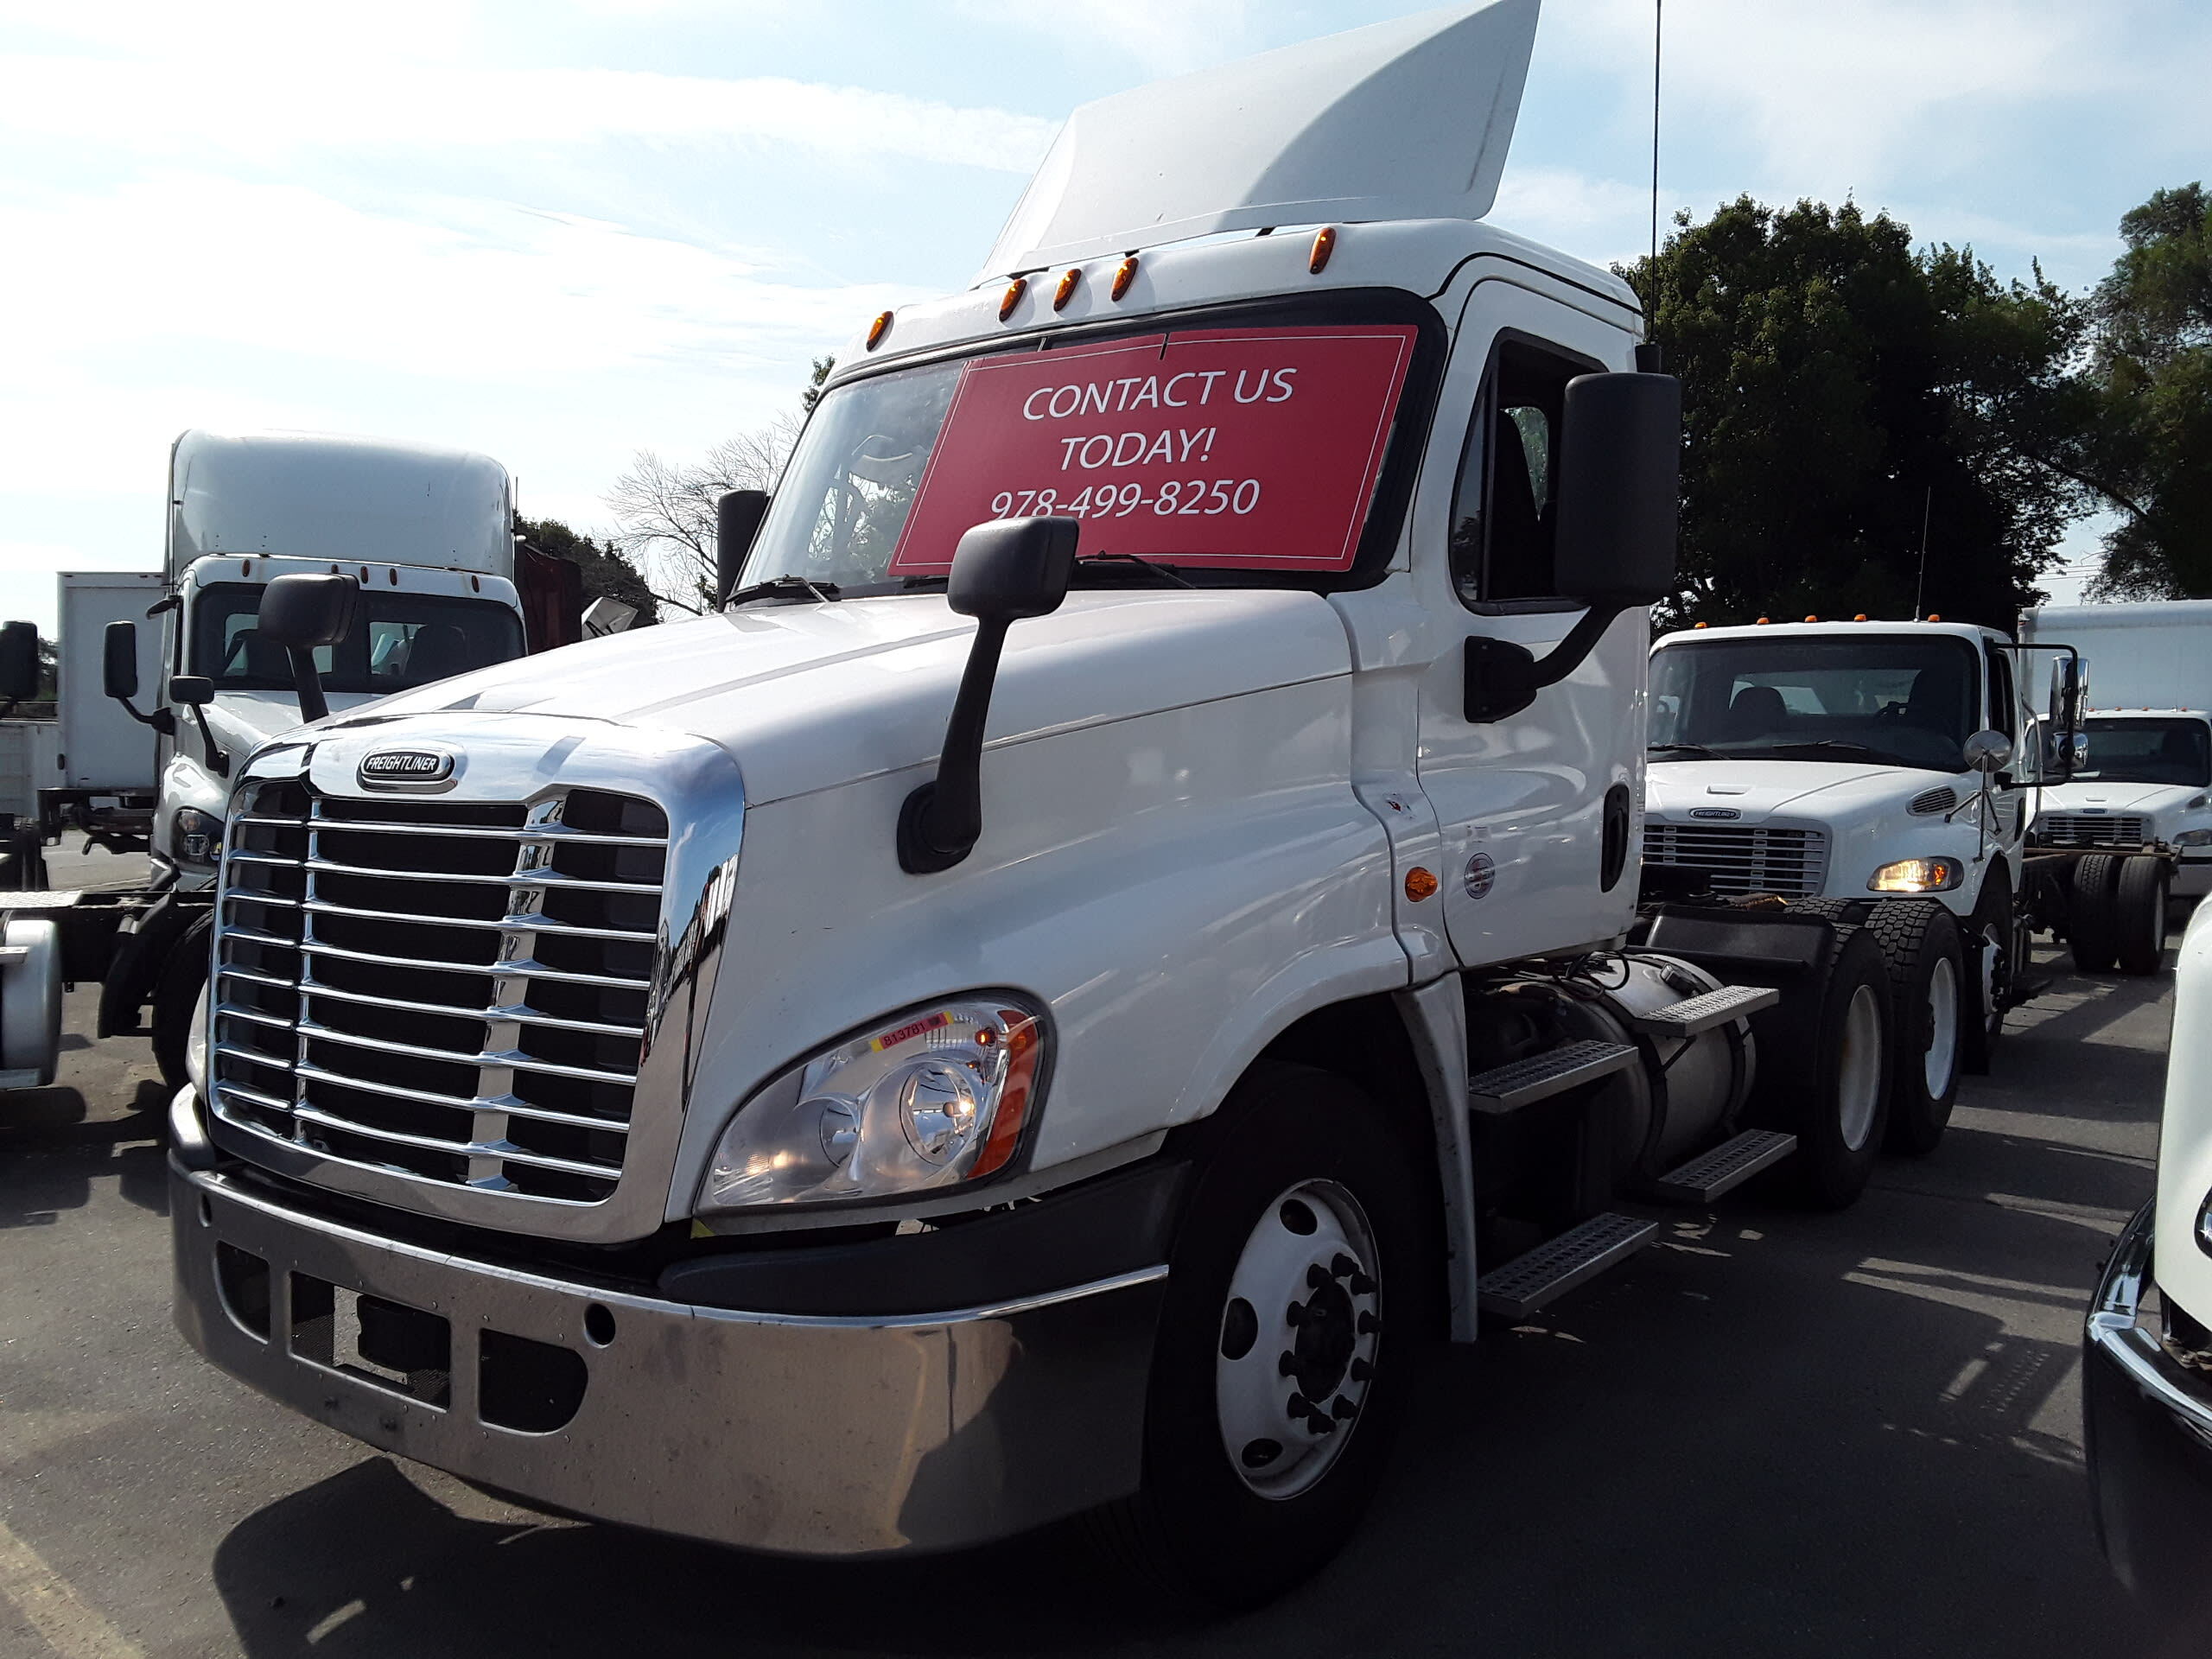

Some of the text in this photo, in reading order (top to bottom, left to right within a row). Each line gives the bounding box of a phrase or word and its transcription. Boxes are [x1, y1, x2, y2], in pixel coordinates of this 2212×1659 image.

[1023, 367, 1297, 421] CONTACT US
[1060, 427, 1216, 471] TODAY!
[990, 479, 1261, 519] 978-499-8250
[365, 755, 436, 771] FREIGHTLINER
[884, 1022, 925, 1046] 813781
